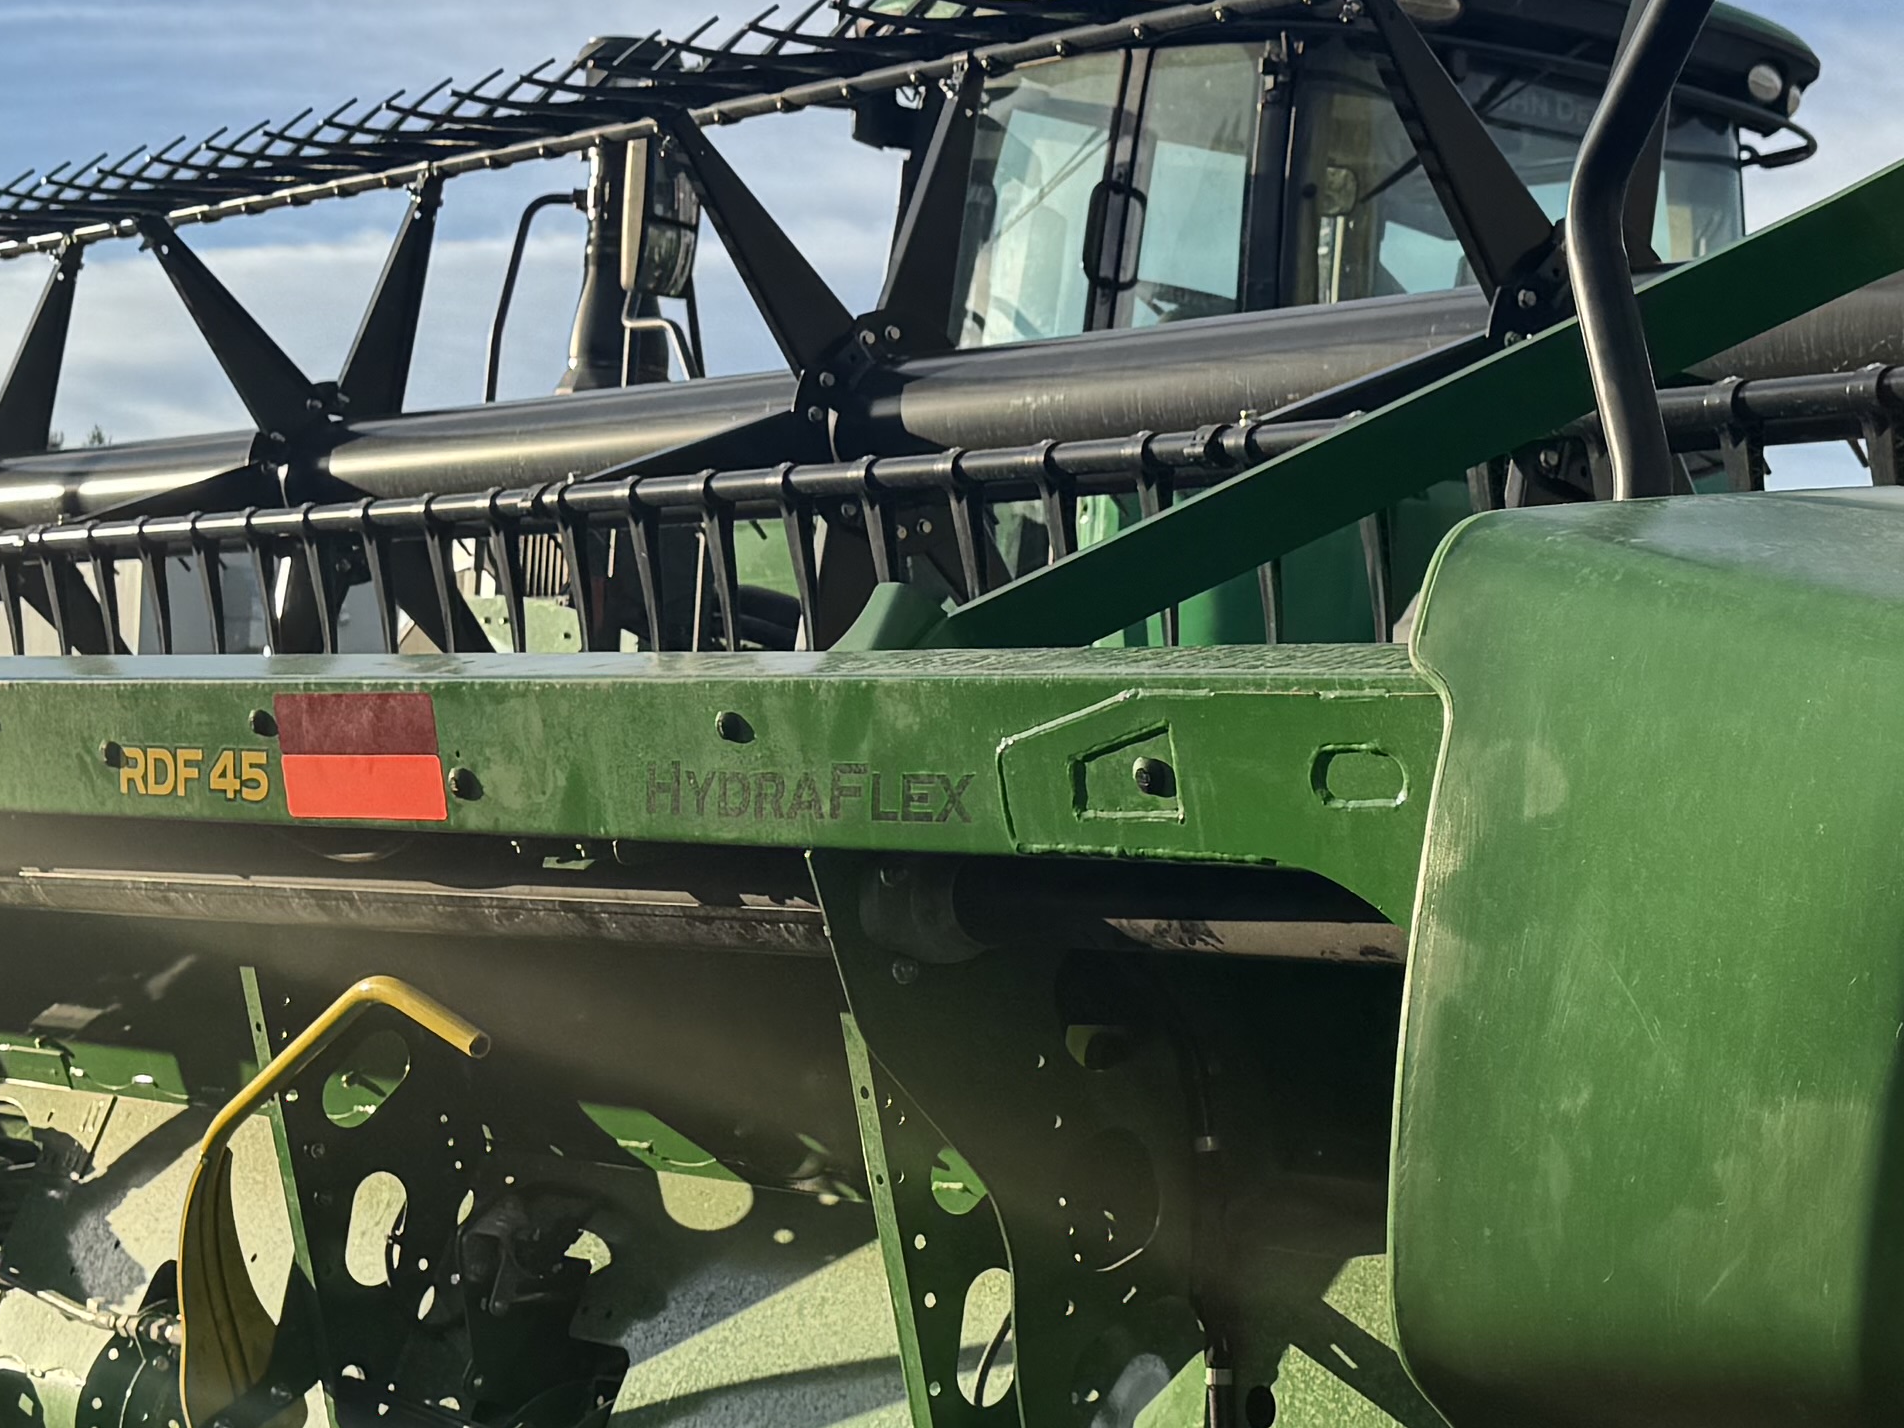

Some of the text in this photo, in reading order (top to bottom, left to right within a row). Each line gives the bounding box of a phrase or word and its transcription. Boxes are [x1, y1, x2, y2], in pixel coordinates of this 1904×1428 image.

[119, 746, 270, 802] RDF 45
[646, 760, 977, 824] HYDRAFLEX
